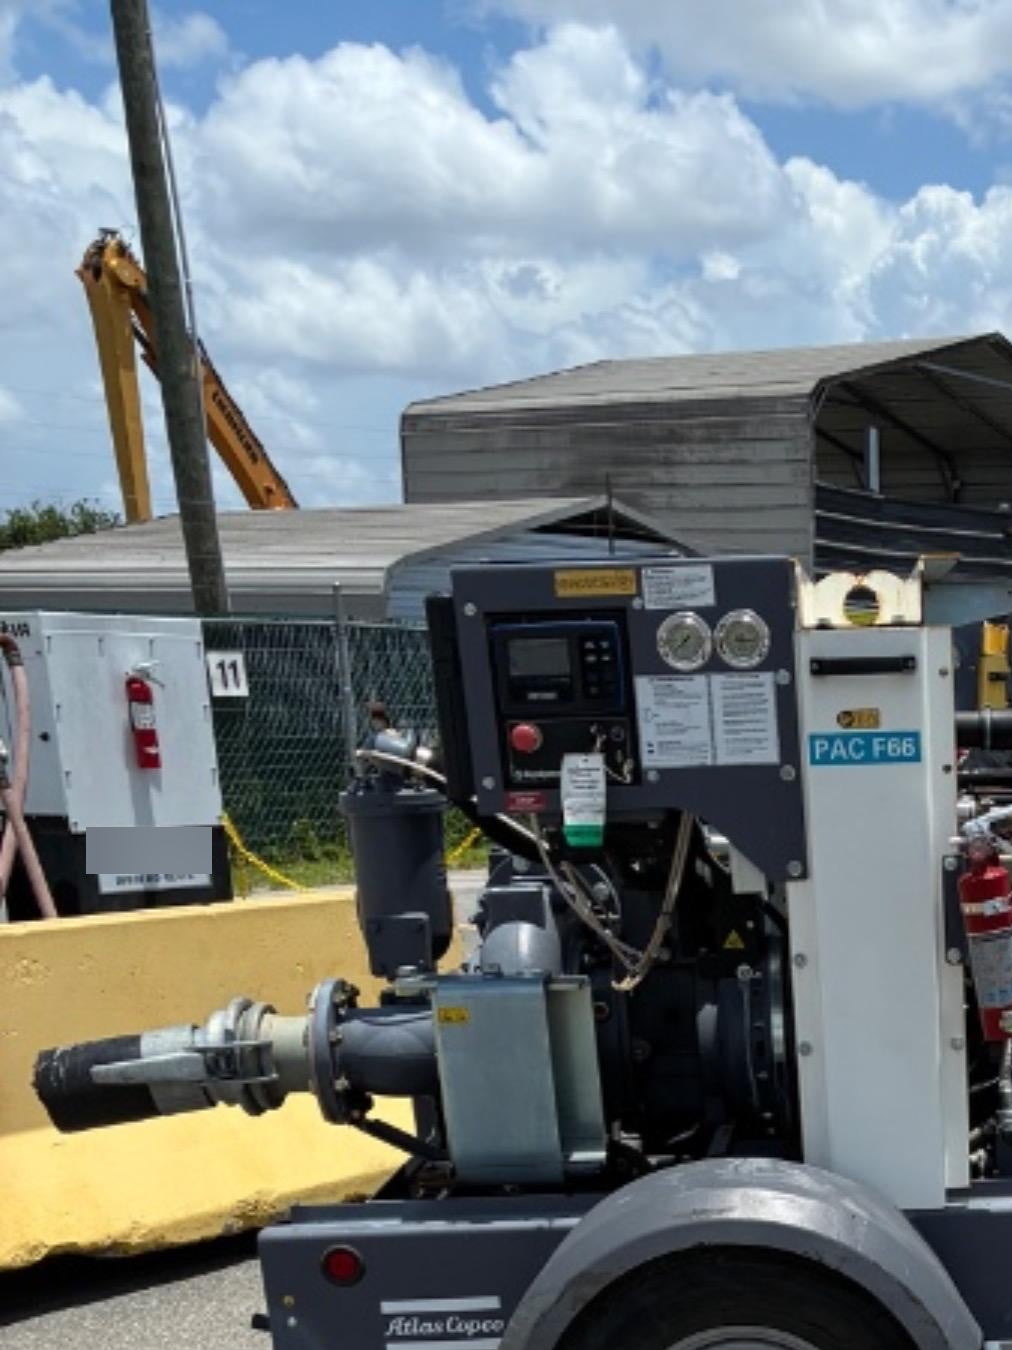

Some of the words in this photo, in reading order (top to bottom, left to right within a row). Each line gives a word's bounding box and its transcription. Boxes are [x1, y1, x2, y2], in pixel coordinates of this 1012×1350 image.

[215, 658, 241, 690] 11
[814, 737, 866, 761] PAC
[871, 736, 917, 759] F66
[385, 1316, 445, 1336] Atlas
[446, 1316, 505, 1336] Copco
